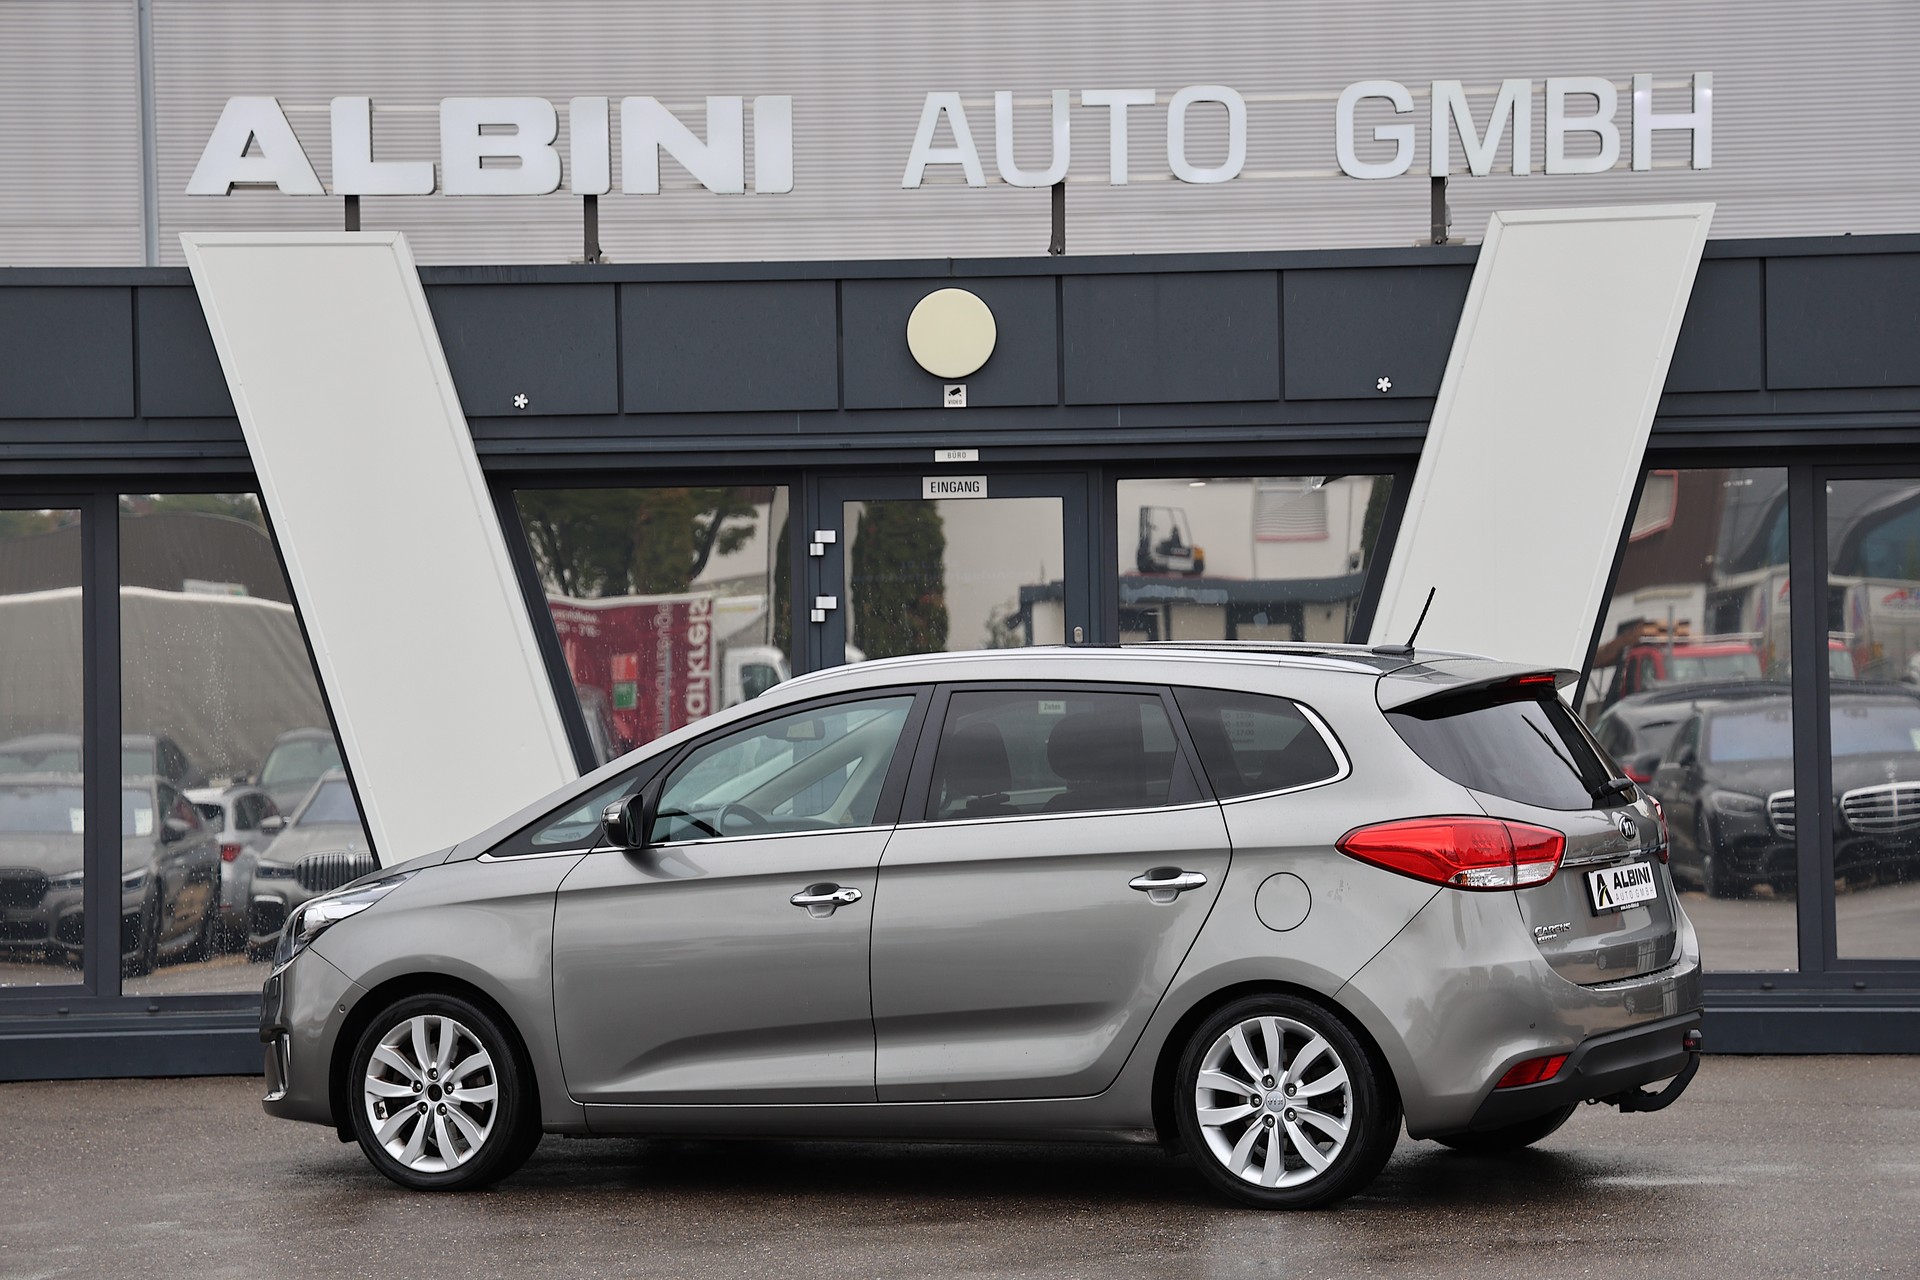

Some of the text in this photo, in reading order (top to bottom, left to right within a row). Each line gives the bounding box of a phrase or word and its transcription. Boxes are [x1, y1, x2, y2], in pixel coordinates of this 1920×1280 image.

[186, 71, 1714, 196] ALBINI AUTO GMBH
[947, 450, 967, 459] BÜRO
[930, 480, 980, 493] EINGANG
[1613, 866, 1651, 890] ALBINI
[1615, 888, 1655, 901] AUTO GMBH
